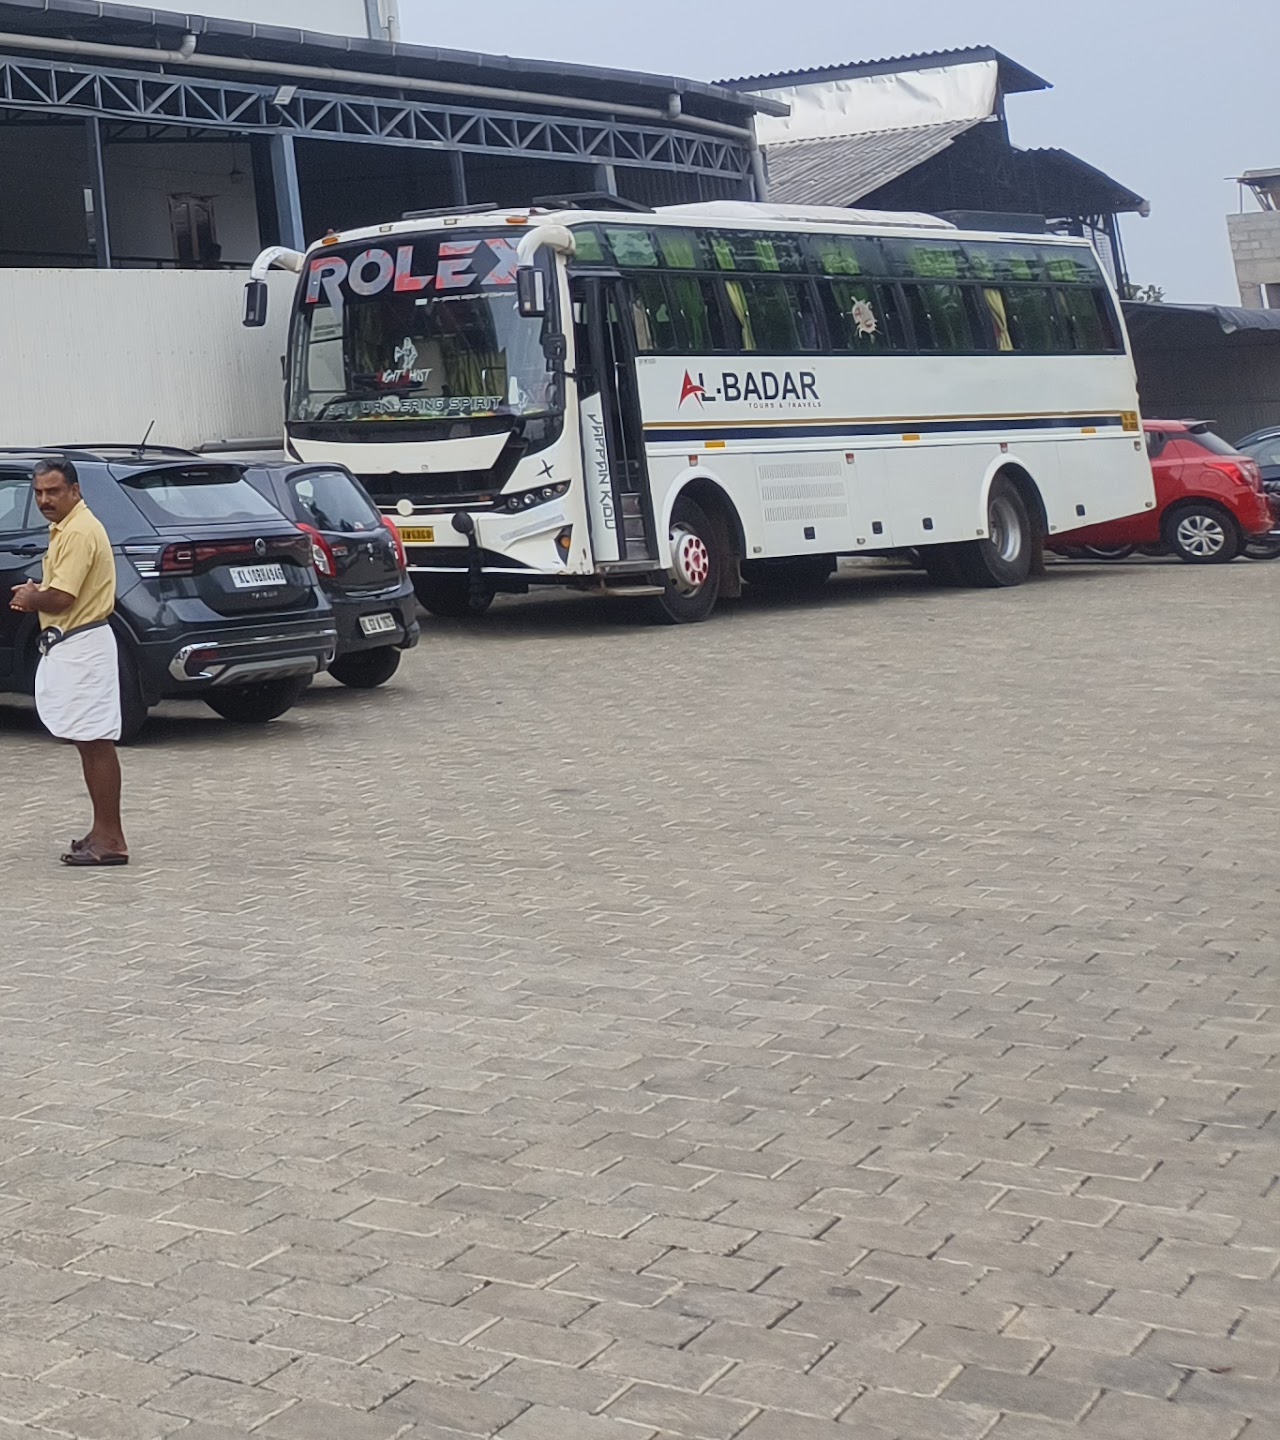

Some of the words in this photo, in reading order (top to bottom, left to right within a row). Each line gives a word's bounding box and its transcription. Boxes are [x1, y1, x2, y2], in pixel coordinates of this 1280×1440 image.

[305, 237, 523, 318] ROLEX
[448, 395, 504, 412] SPIRIT
[677, 368, 820, 411] AL-BADAR
